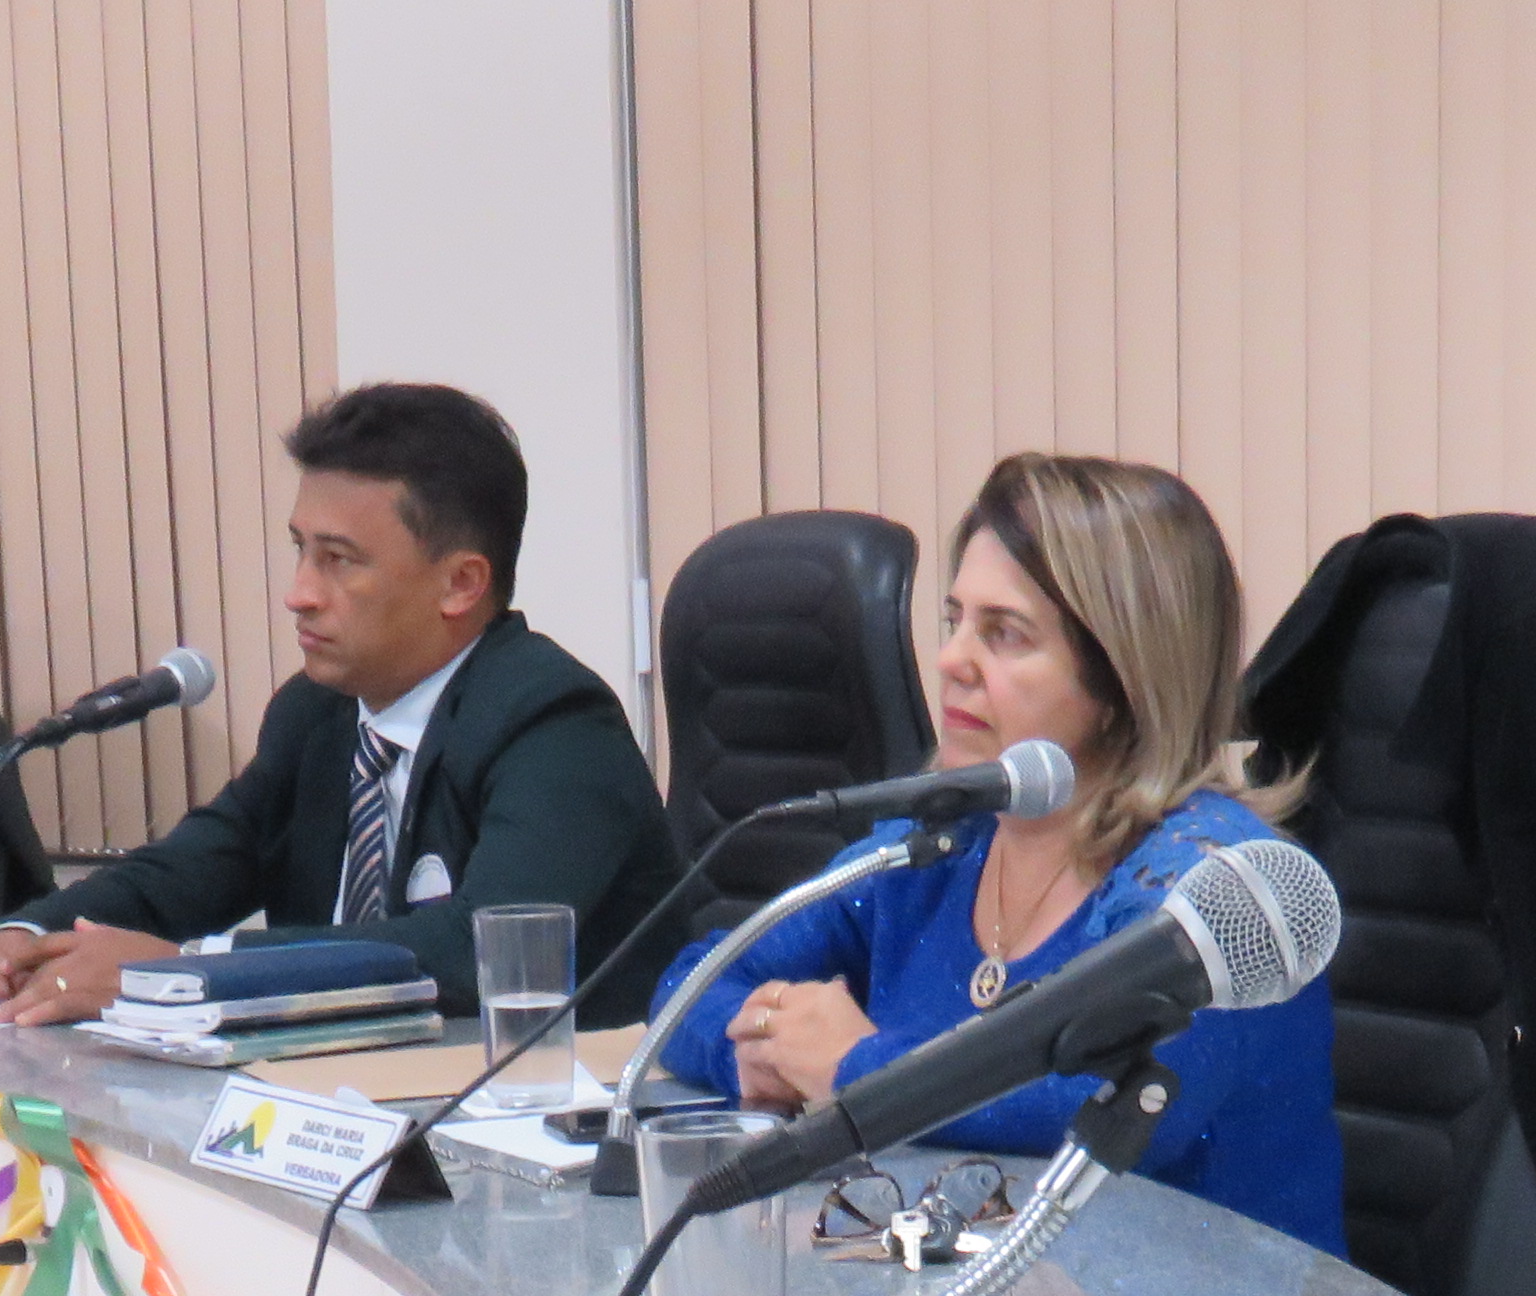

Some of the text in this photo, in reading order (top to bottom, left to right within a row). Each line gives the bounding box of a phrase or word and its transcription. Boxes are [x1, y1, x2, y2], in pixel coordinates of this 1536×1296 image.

[302, 1119, 365, 1144] DARCI MARIA
[286, 1132, 364, 1162] BRAGA DA CRUZ
[284, 1162, 341, 1186] VEREADORA
